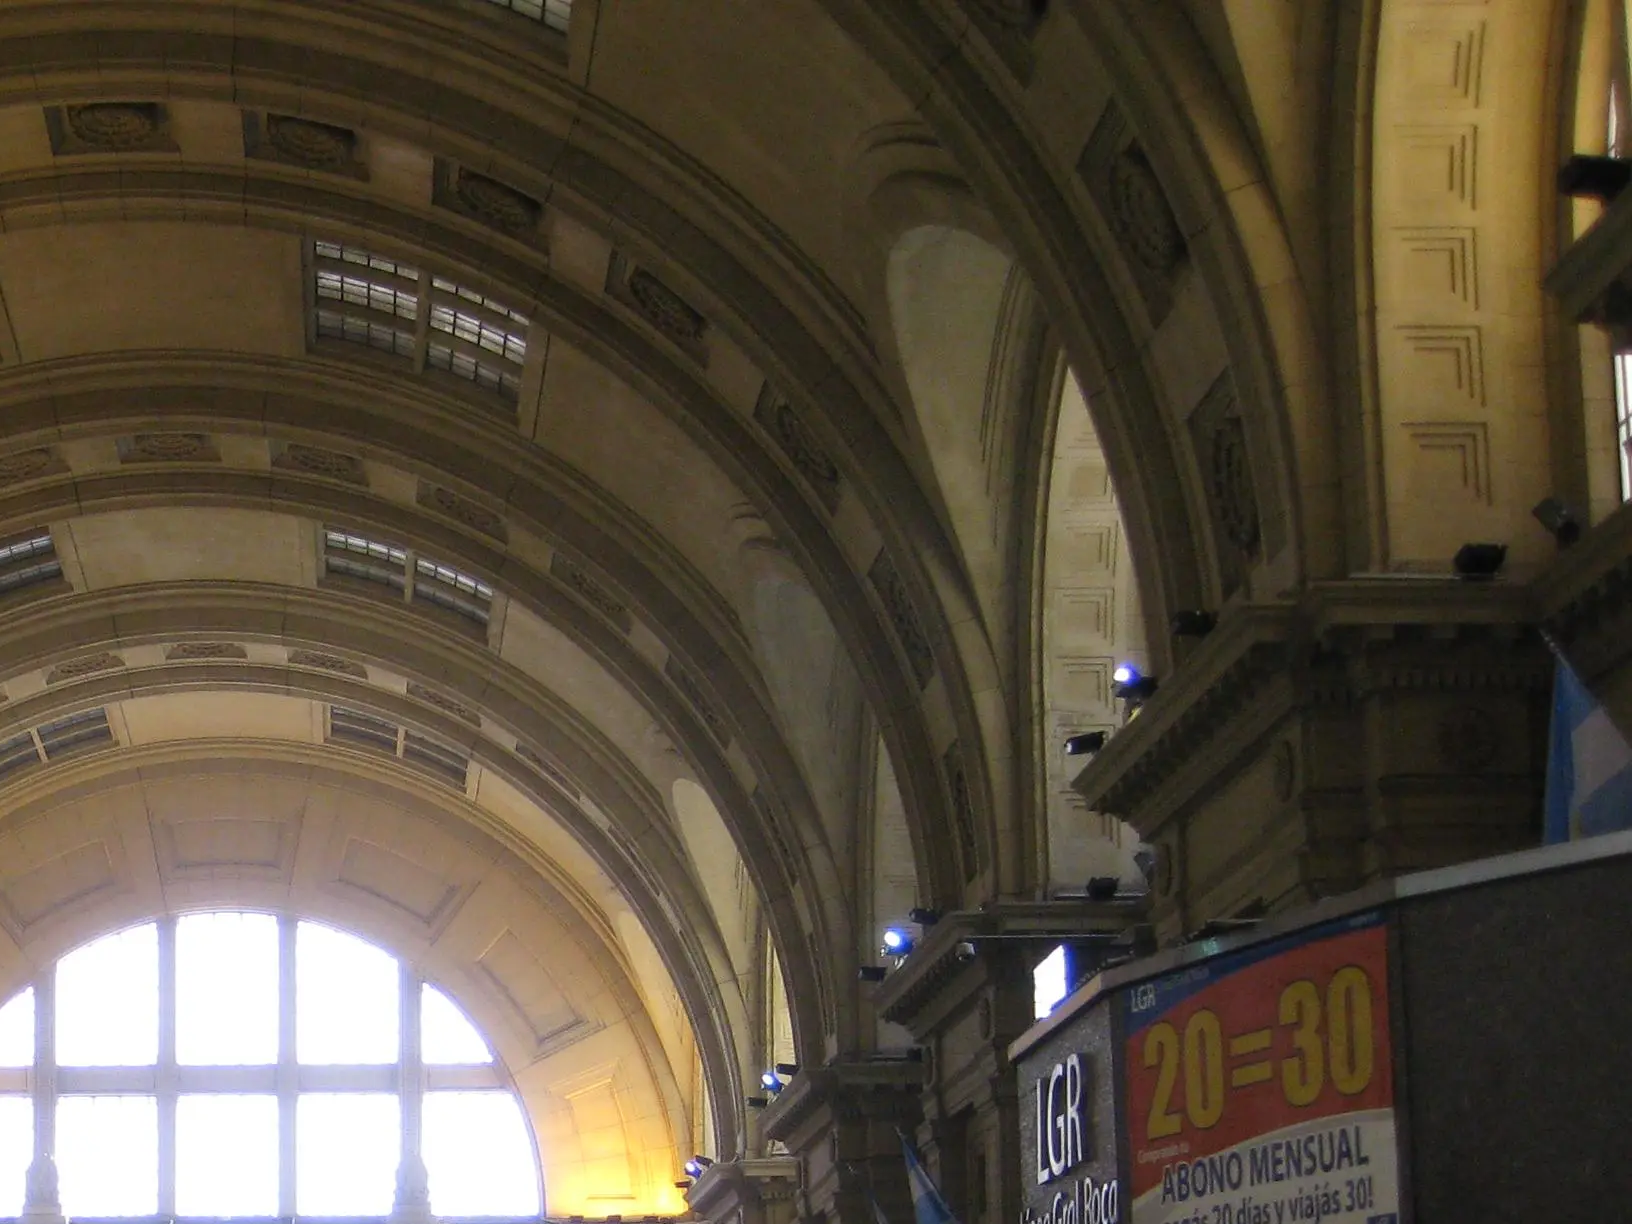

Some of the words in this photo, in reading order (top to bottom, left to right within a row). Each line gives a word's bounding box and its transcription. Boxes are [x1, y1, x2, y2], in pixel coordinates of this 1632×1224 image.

[1131, 984, 1156, 1013] LGR
[1144, 966, 1374, 1140] 20=30
[1037, 1053, 1082, 1185] LGR
[1161, 1150, 1243, 1205] ABONO
[1250, 1124, 1369, 1186] MENSUAL
[1345, 1175, 1374, 1212] 30!
